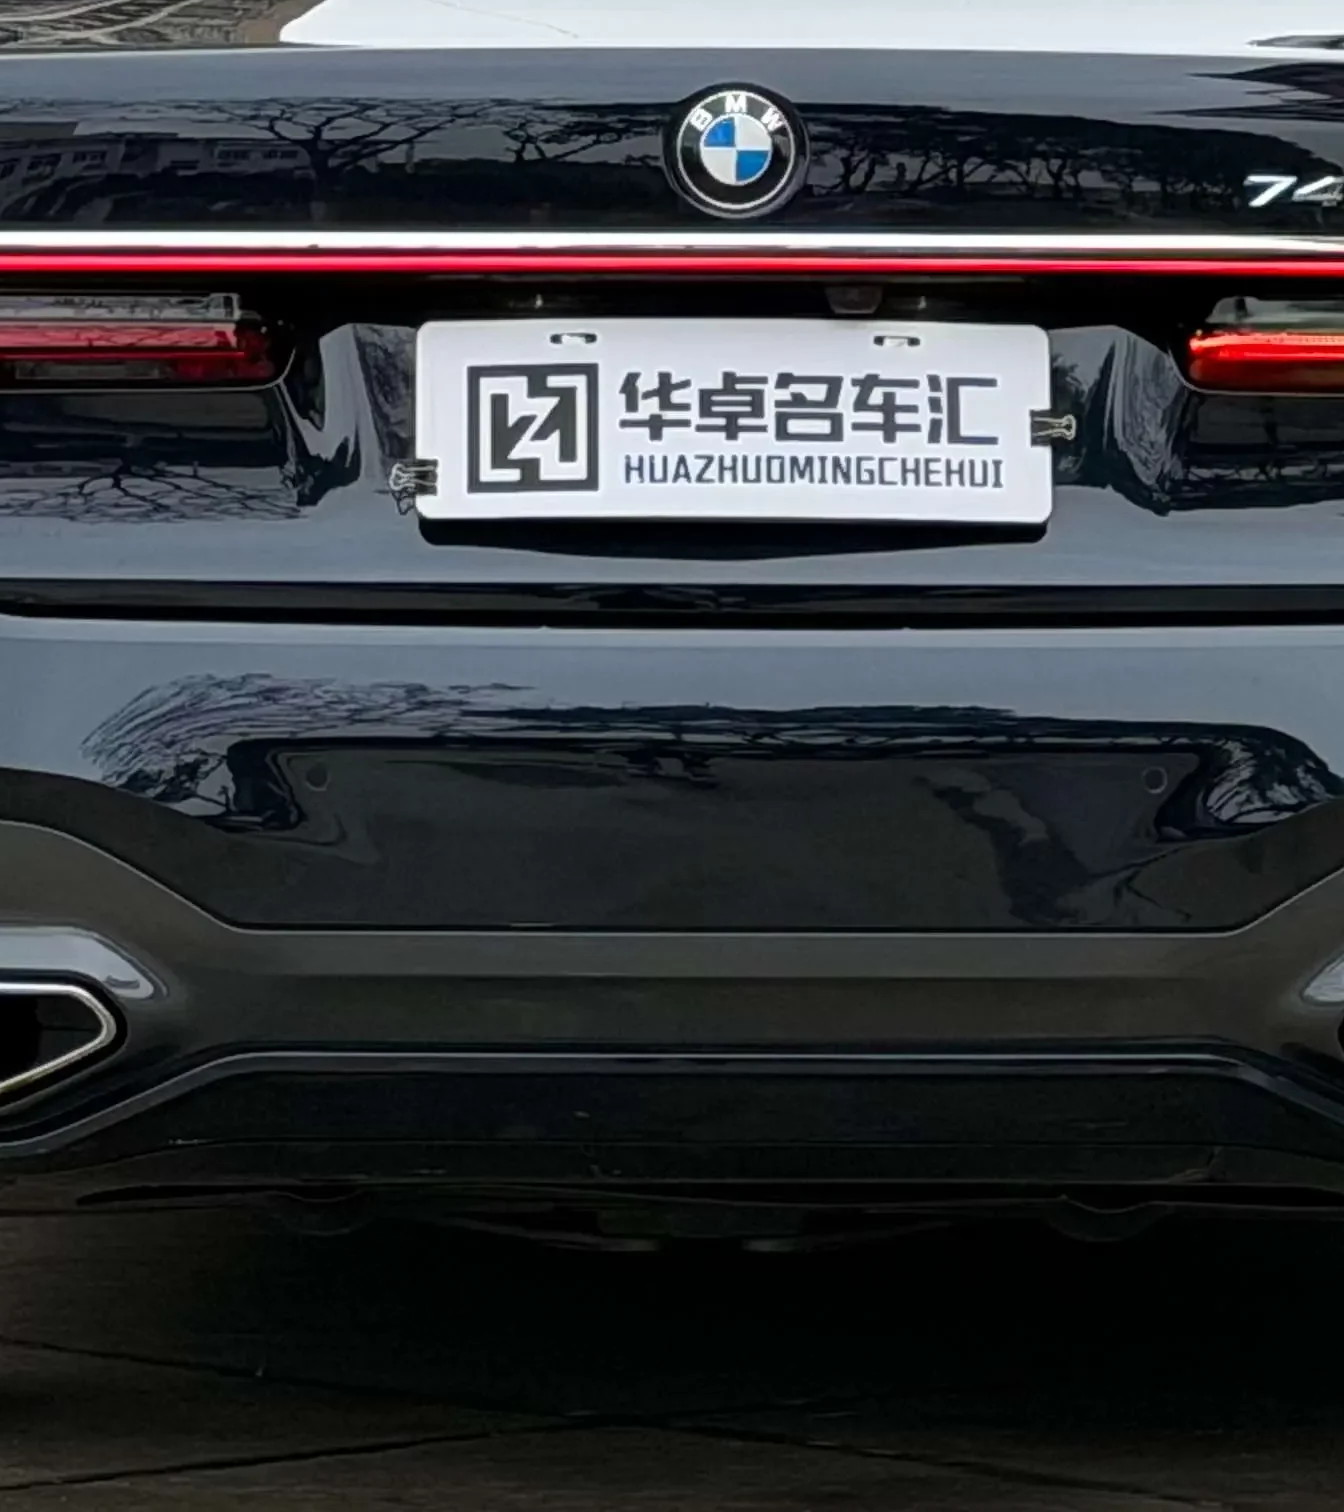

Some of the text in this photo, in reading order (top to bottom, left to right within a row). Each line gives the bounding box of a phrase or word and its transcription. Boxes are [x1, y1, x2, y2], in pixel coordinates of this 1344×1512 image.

[690, 92, 784, 132] BMW
[618, 371, 999, 445] 华卓名车汇
[623, 455, 1004, 490] HUAZHUOMINGCHEHUI
